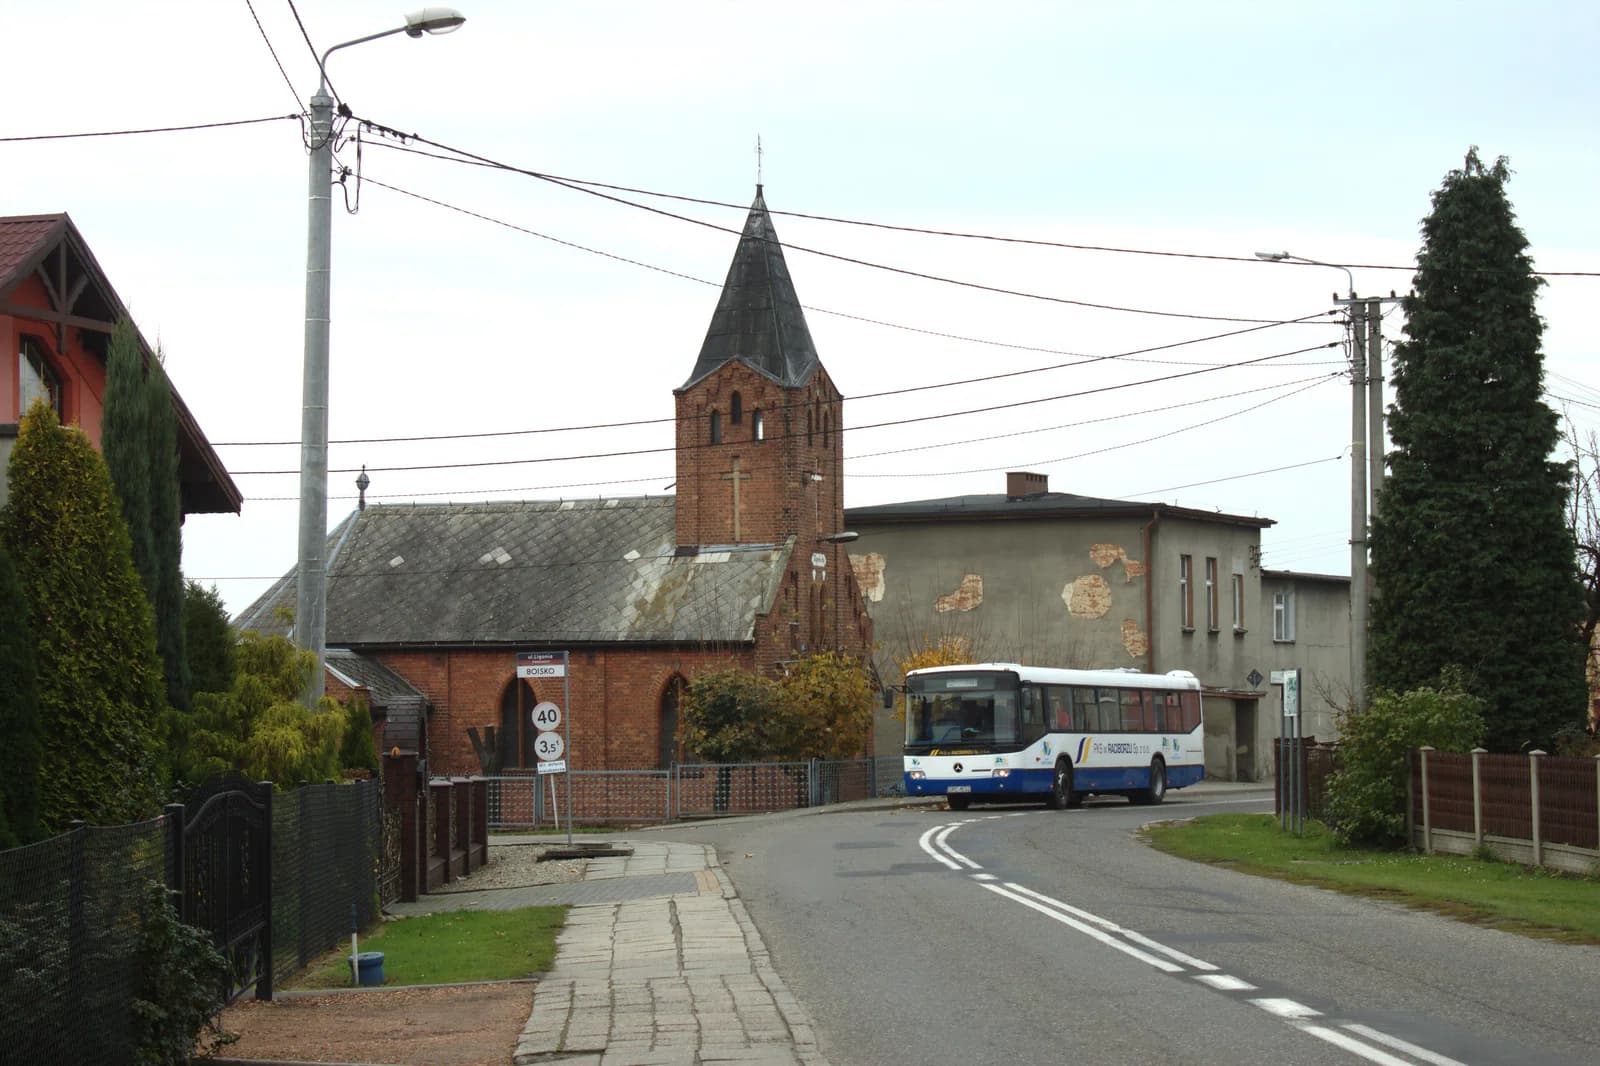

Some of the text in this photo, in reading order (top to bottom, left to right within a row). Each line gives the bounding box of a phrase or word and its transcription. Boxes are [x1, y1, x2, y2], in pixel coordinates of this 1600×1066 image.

[526, 667, 555, 676] BOISKO
[537, 708, 557, 724] 40
[1108, 743, 1133, 754] RACIBORZU
